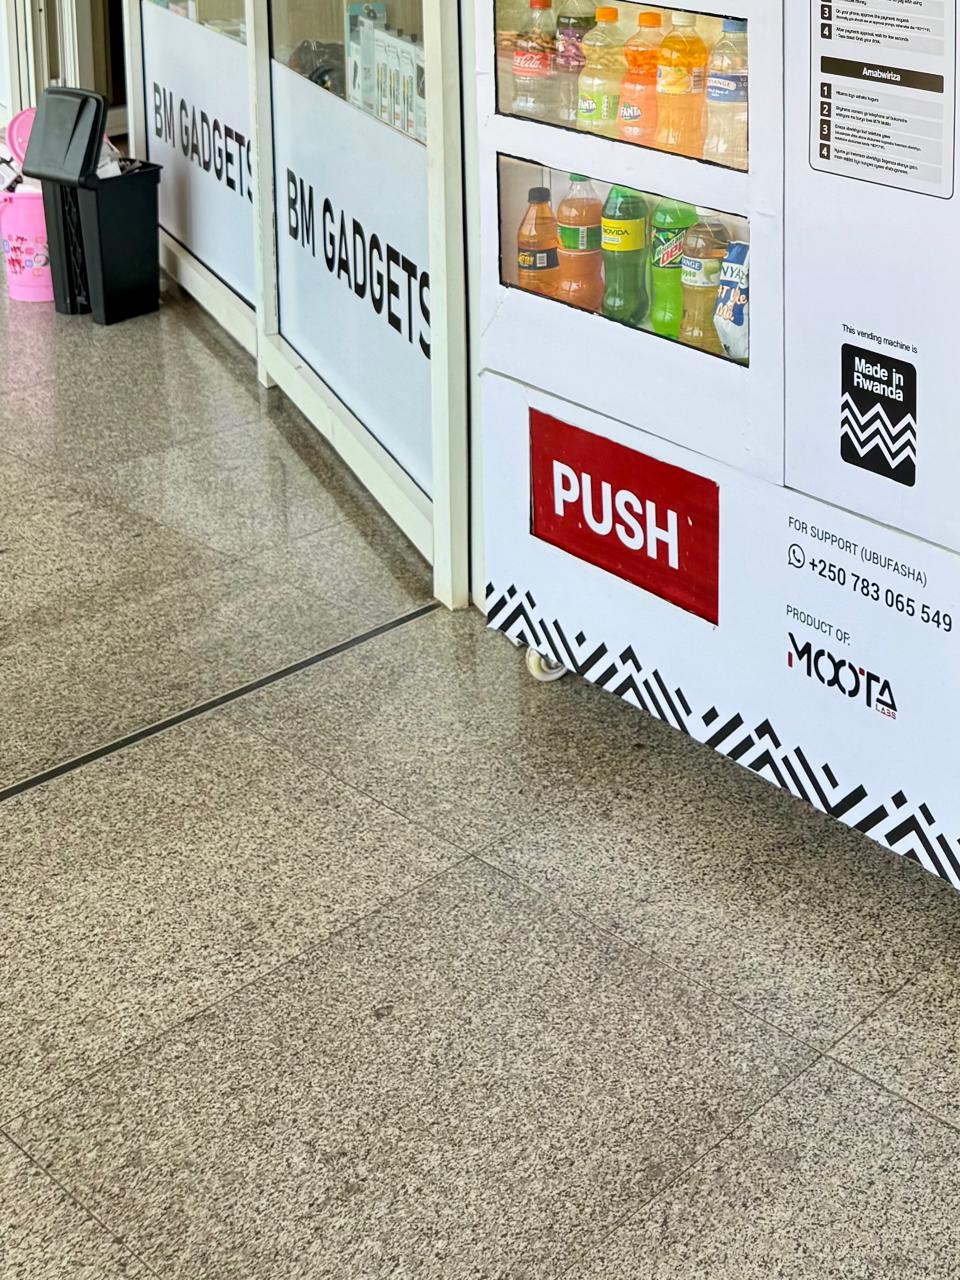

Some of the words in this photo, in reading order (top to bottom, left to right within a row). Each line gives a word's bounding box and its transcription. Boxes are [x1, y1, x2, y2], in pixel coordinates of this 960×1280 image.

[823, 7, 829, 17] 3
[823, 26, 829, 36] 4
[862, 67, 901, 81] Amabwiriza
[822, 86, 828, 95] 1
[153, 82, 176, 149] BM
[823, 105, 829, 114] 2
[822, 125, 828, 135] 3
[821, 147, 828, 156] 4
[287, 167, 316, 258] BM
[322, 197, 432, 360] GADGETS
[842, 323, 856, 335] This
[856, 329, 882, 345] vending
[883, 337, 911, 352] machine
[911, 344, 918, 354] is
[853, 371, 904, 402] Rwanda
[854, 356, 889, 381] Made
[892, 368, 904, 387] in
[552, 459, 679, 570] PUSH
[788, 516, 808, 535] FOR
[810, 525, 859, 556] SUPPORT
[860, 546, 928, 588] (UBUFASHA)
[809, 557, 846, 586] +250
[850, 572, 880, 601] 783
[885, 588, 915, 617] 065
[920, 603, 953, 632] 549
[786, 604, 833, 636] PRODUCT
[835, 627, 851, 646] OF:
[787, 631, 898, 712] MOOTA
